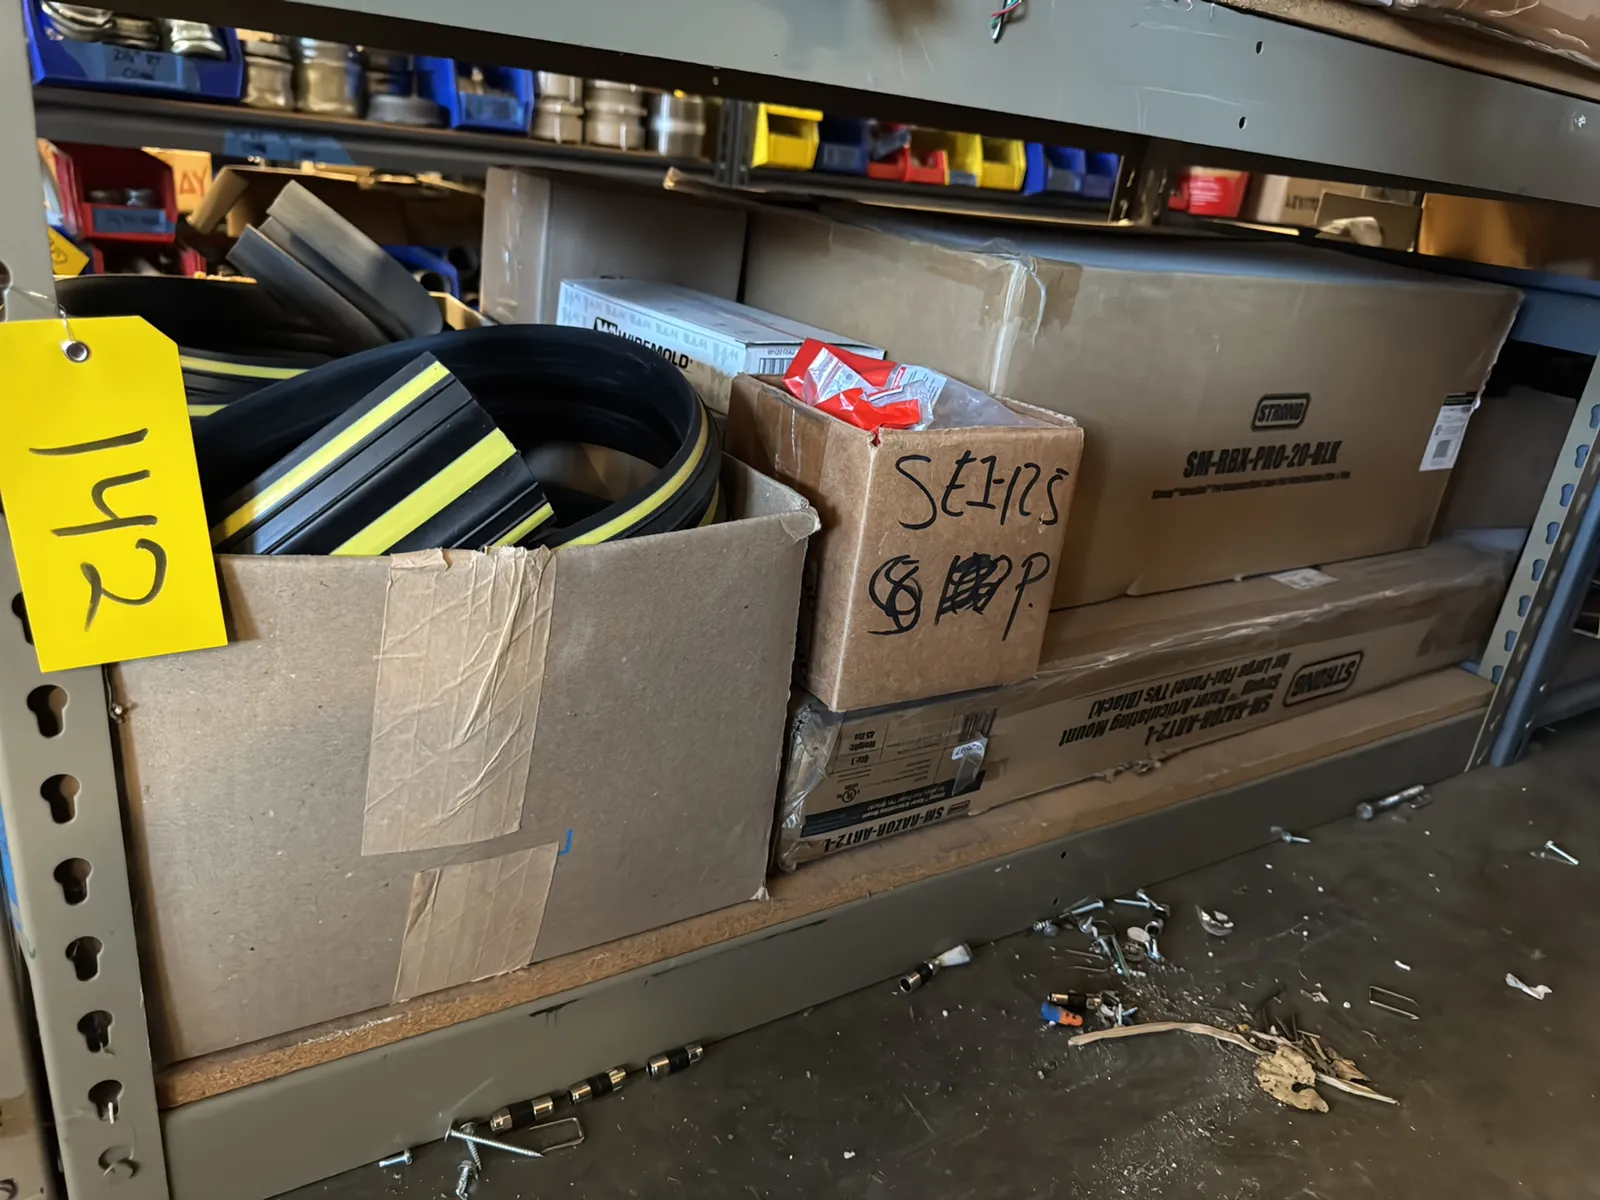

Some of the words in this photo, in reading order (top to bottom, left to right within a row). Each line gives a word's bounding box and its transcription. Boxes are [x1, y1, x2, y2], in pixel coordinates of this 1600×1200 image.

[29, 428, 167, 632] 142
[1059, 719, 1106, 746] Mount
[1109, 700, 1192, 733] Articulating
[824, 806, 944, 852] SM-RAZOR-ART2-L
